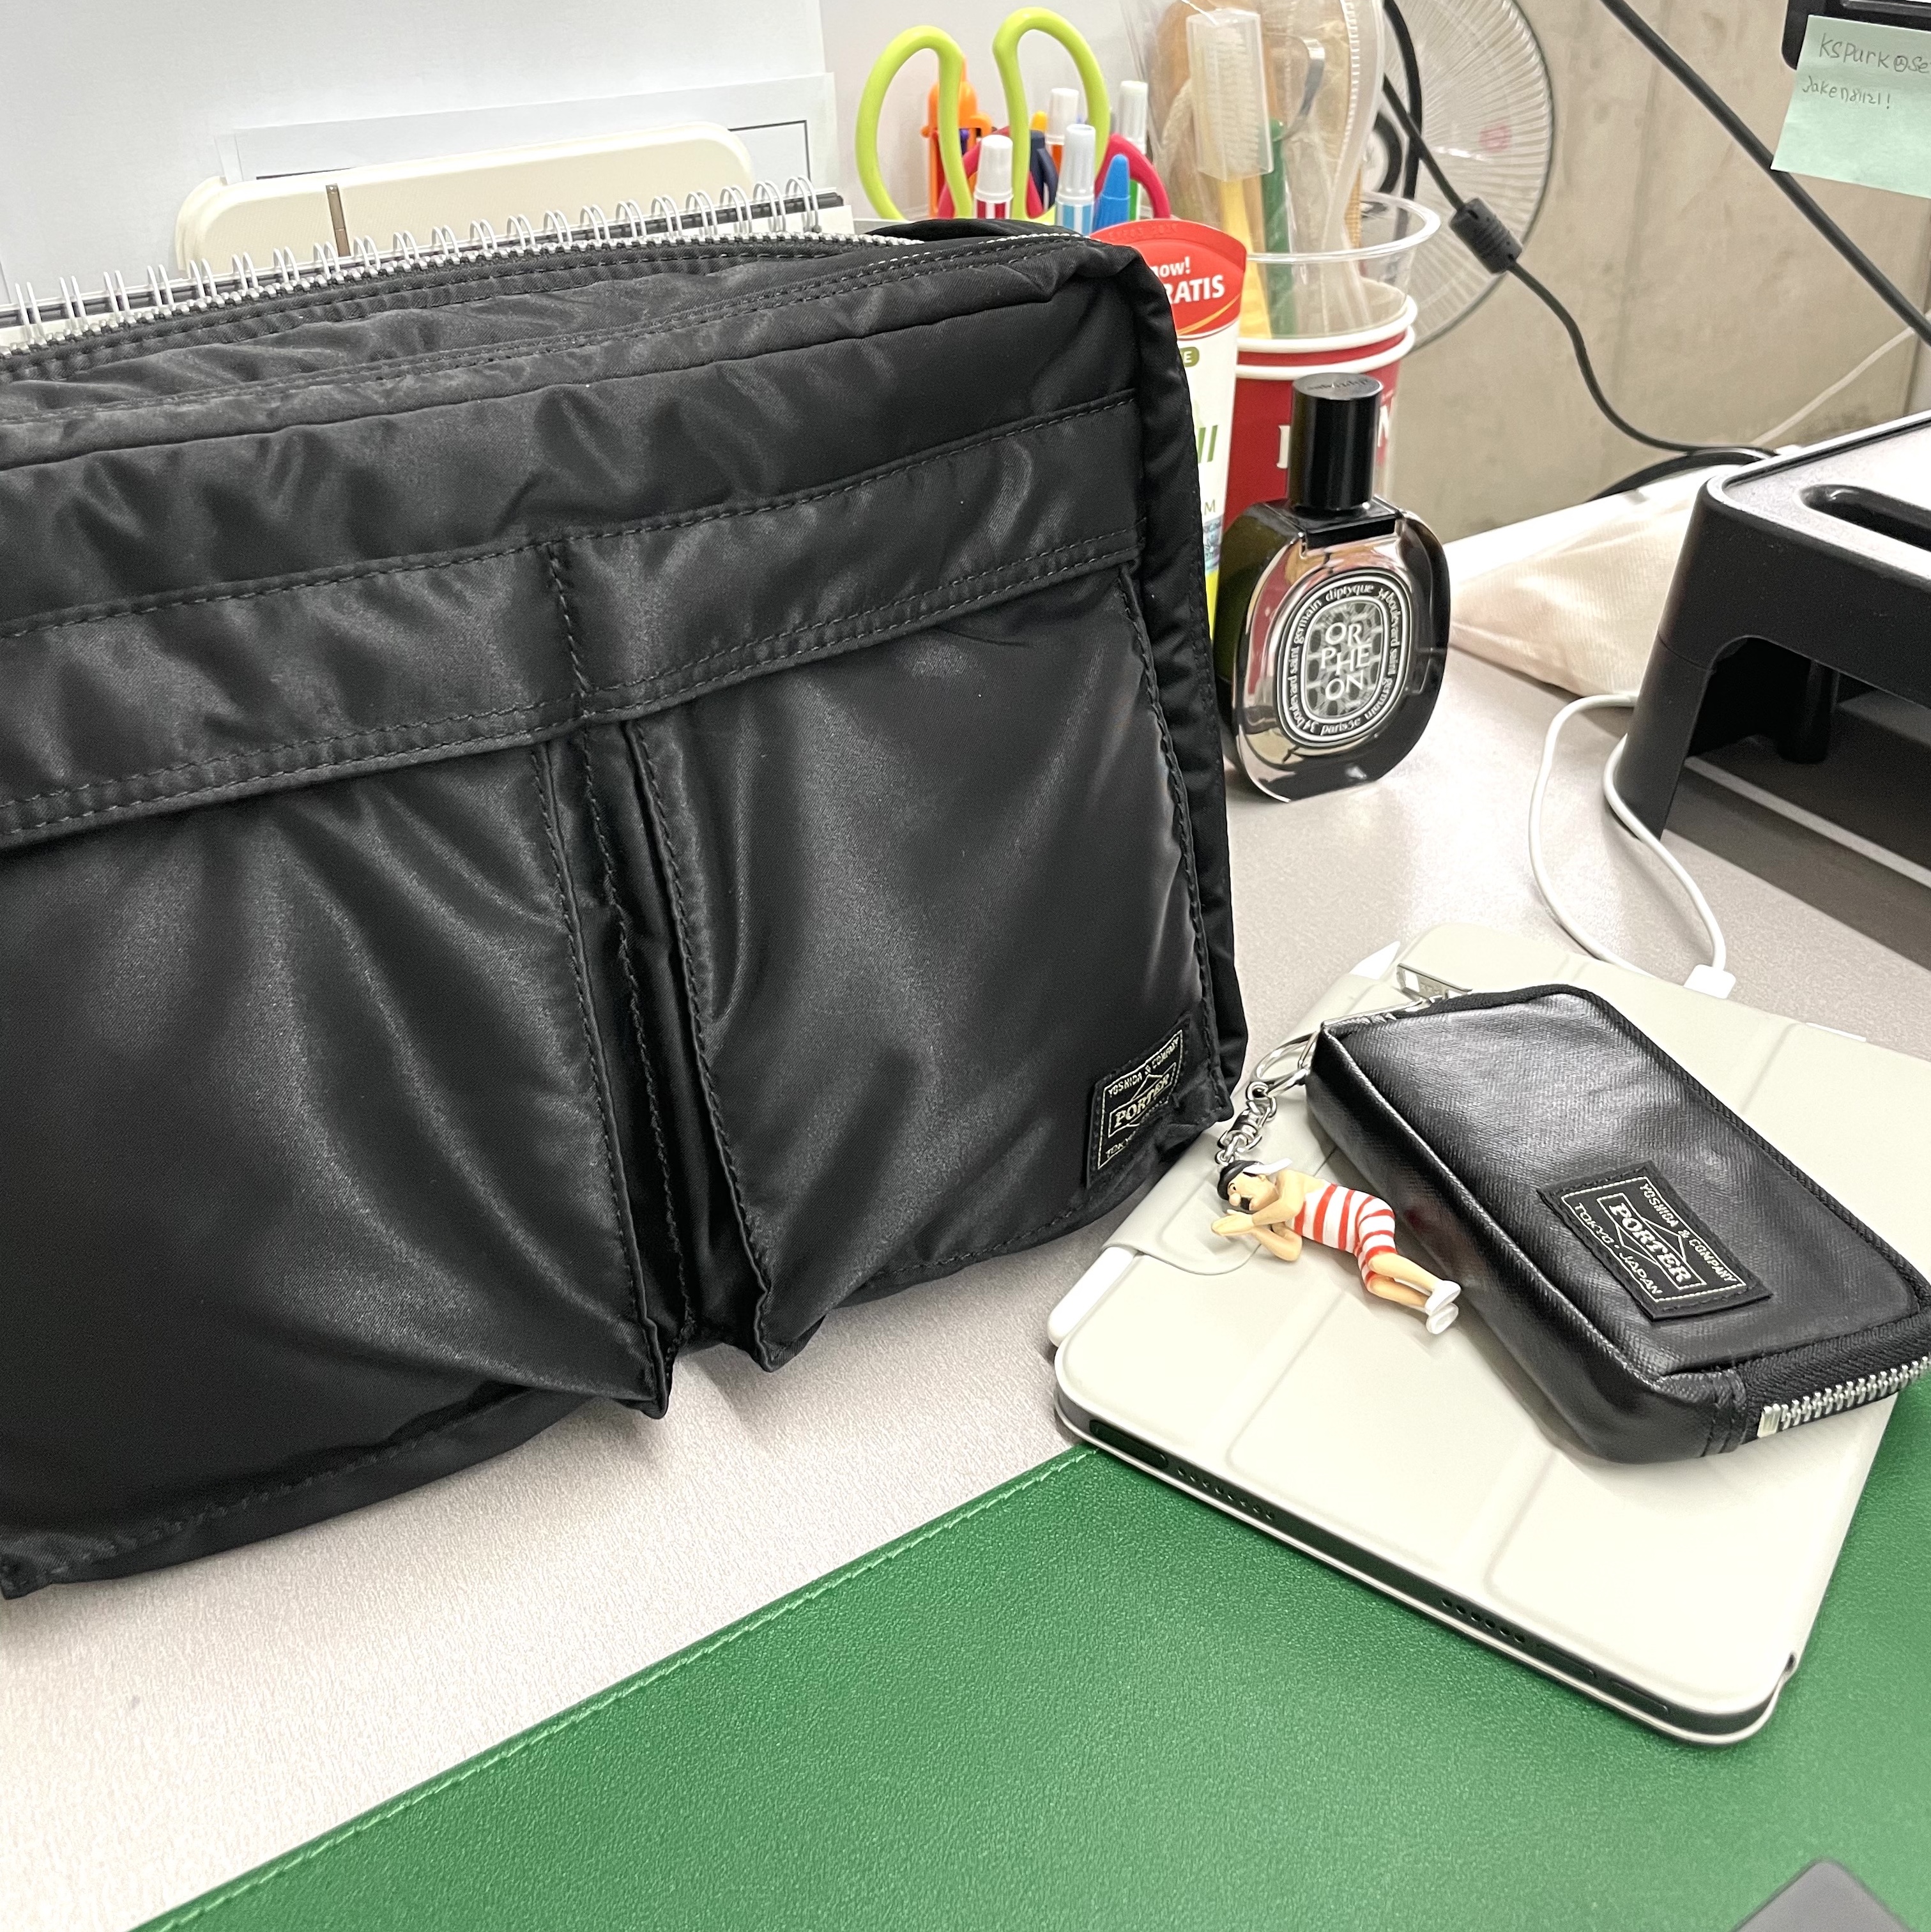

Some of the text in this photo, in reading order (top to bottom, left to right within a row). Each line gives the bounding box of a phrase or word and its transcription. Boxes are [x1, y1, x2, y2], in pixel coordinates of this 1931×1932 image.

[1163, 274, 1225, 305] RATIS
[1325, 584, 1374, 601] diptyque
[1294, 599, 1322, 644] germain
[1325, 622, 1362, 646] OR
[1385, 592, 1401, 647] boulevard
[1289, 646, 1301, 674] saint
[1321, 643, 1372, 676] PHE
[1387, 648, 1398, 676] saint
[1287, 676, 1305, 728] boulevard
[1325, 669, 1362, 700] ON
[1364, 677, 1393, 720] germain
[1108, 1072, 1143, 1099] YOSHIDA
[1152, 1036, 1179, 1069] COMPANY
[1113, 1074, 1170, 1129] PORTER
[1575, 1202, 1663, 1294] TOKYO JAPAN
[1608, 1203, 1691, 1282] PORTER
[1639, 1183, 1679, 1227] YOSHIDA
[1688, 1238, 1737, 1281] COMPANY
